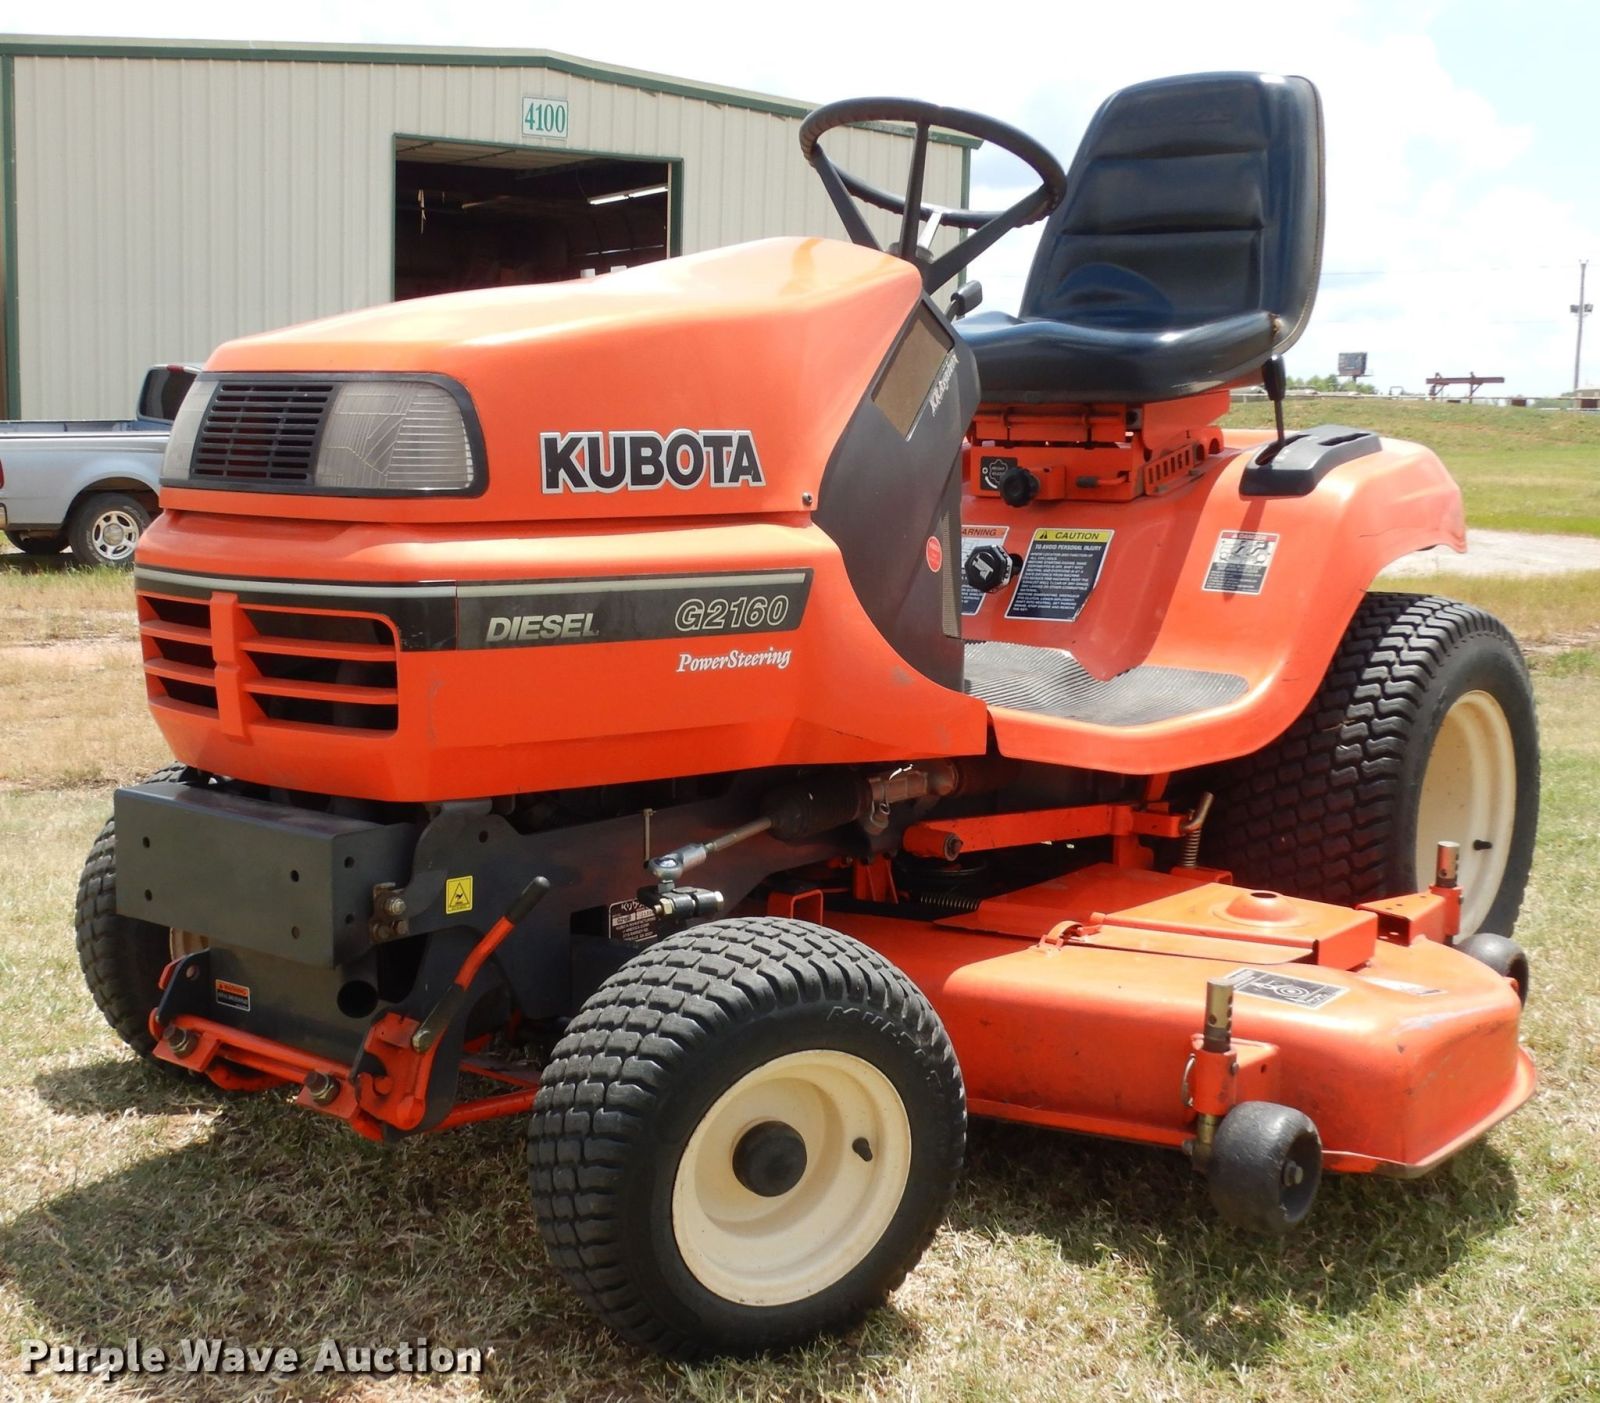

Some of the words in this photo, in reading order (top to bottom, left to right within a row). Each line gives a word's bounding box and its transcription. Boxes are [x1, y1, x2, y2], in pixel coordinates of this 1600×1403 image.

[525, 102, 566, 133] 4100
[540, 429, 766, 494] KUBOTA
[961, 528, 997, 537] ARNING
[1055, 531, 1100, 540] CAUTION
[486, 613, 599, 643] DIESEL
[675, 595, 789, 632] G2160
